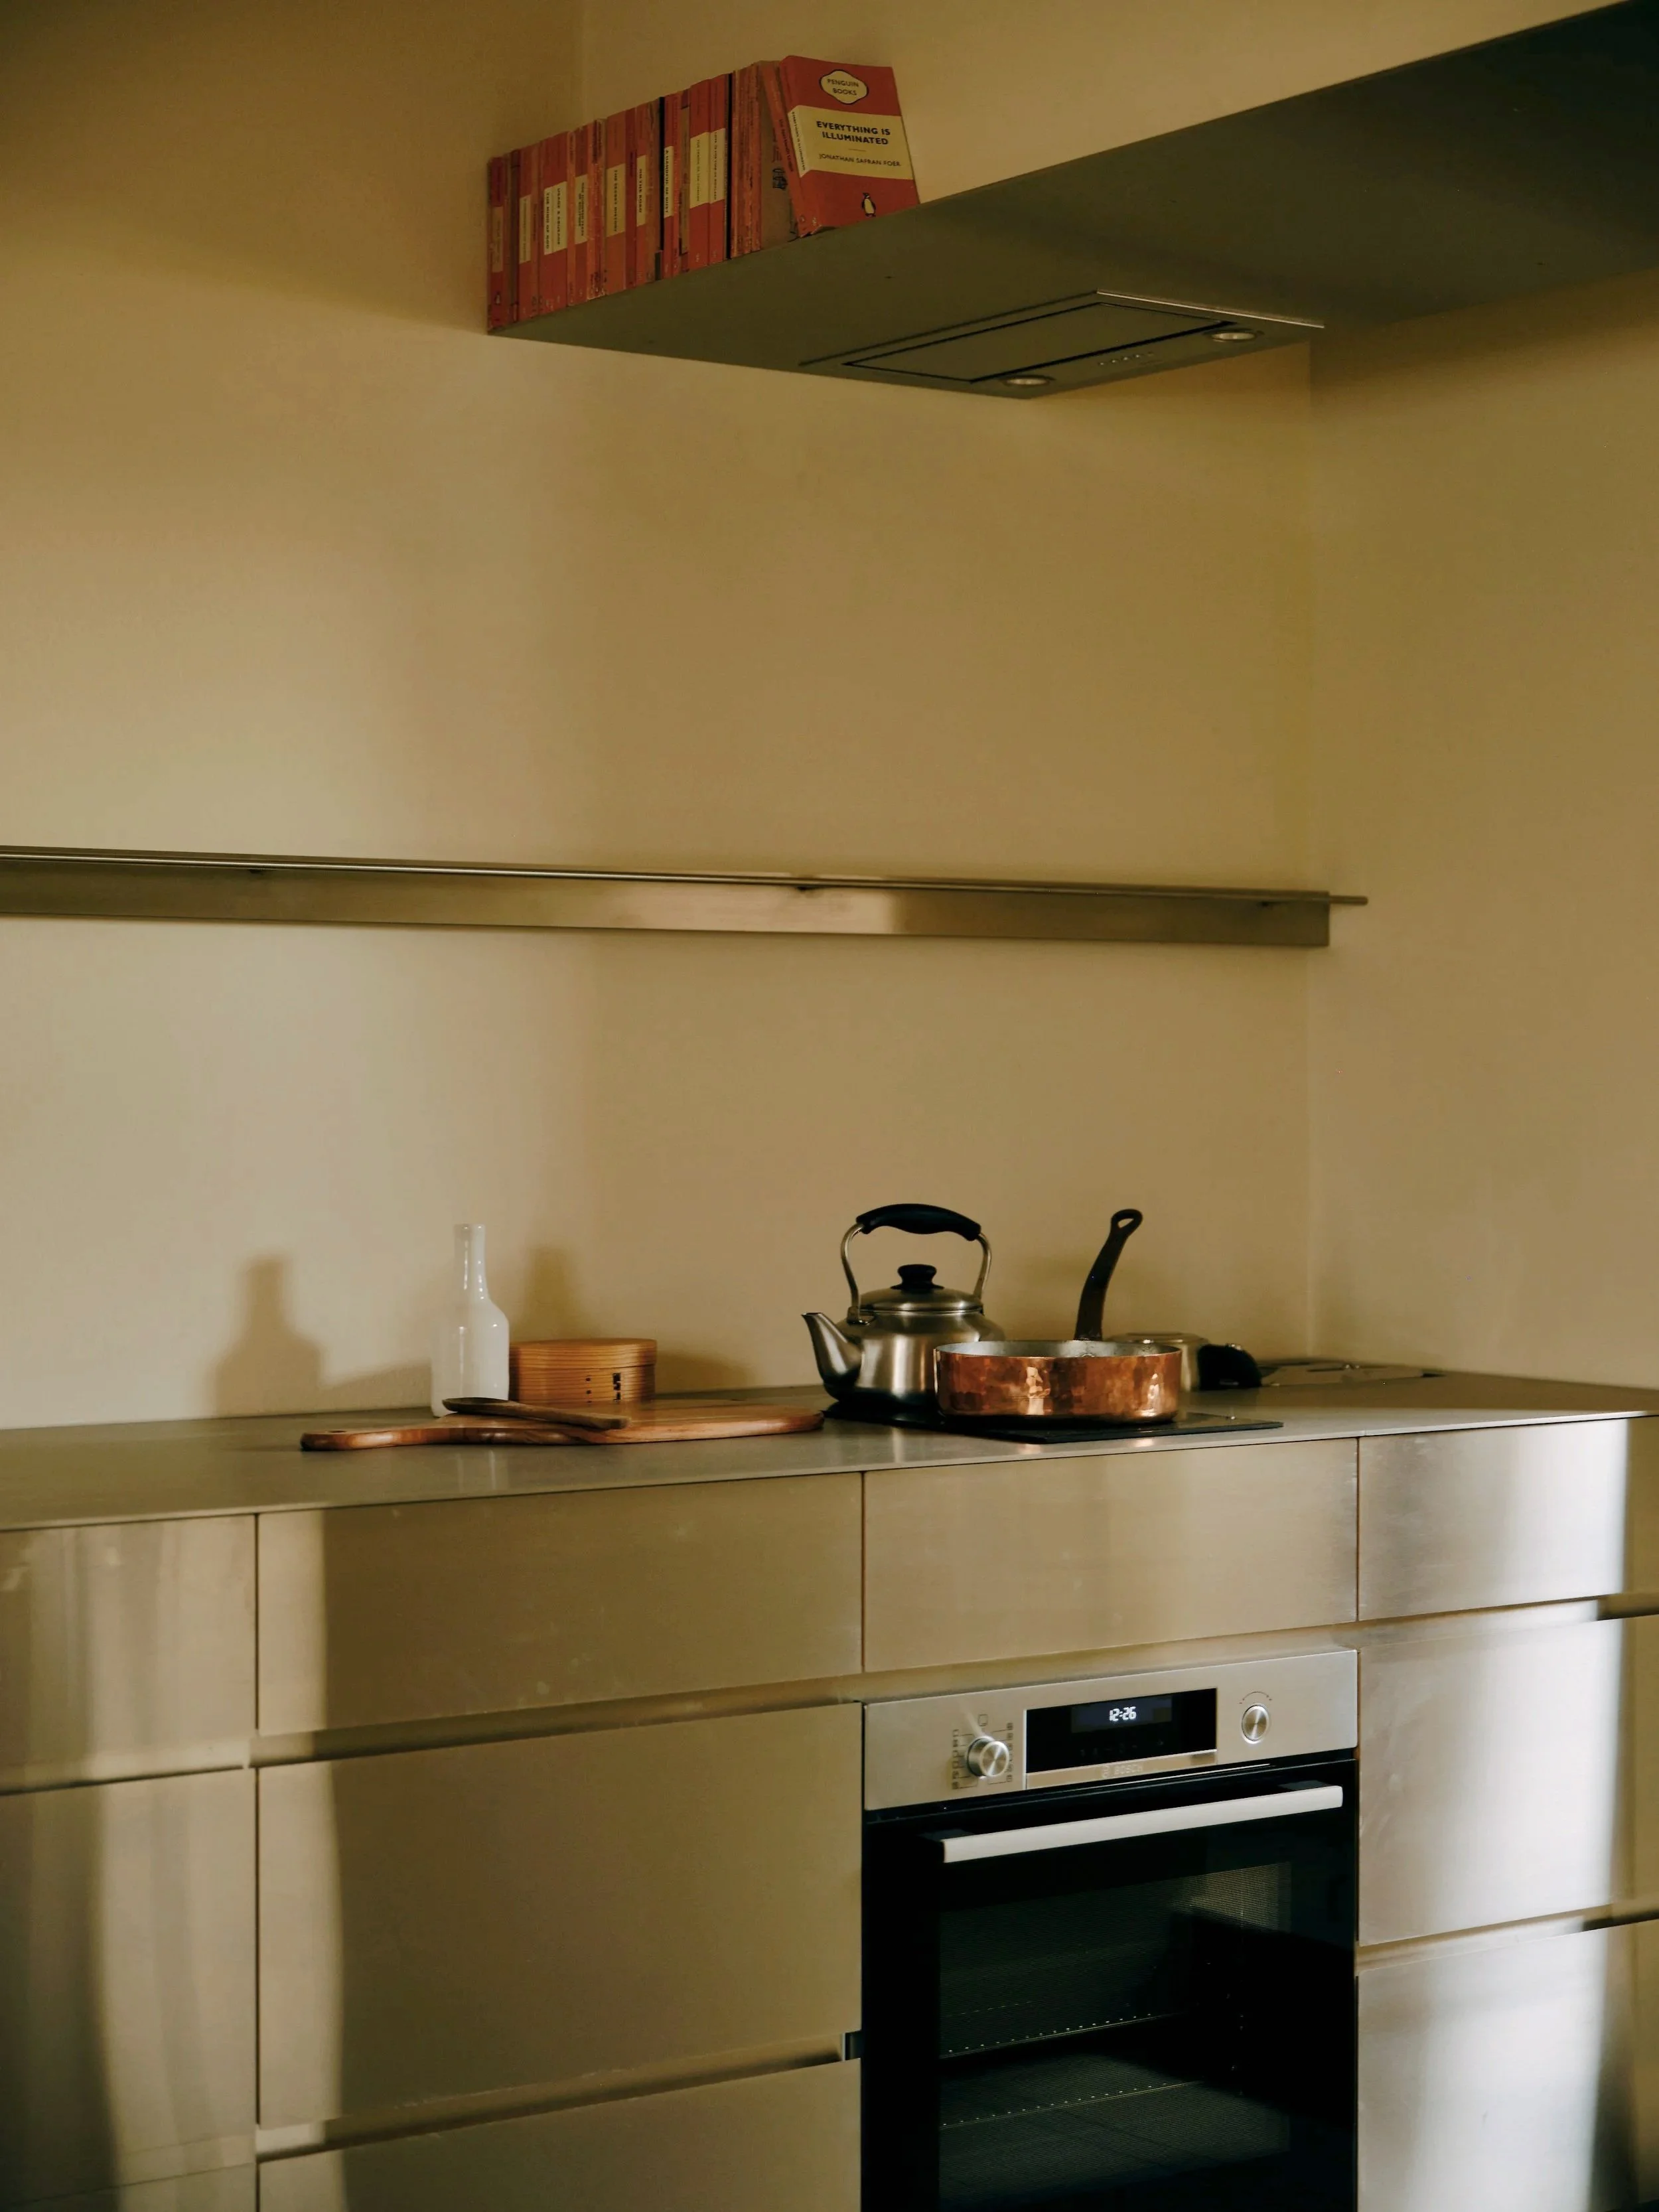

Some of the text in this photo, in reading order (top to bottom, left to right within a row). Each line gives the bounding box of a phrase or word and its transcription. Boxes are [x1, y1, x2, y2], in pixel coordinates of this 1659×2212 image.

[827, 78, 859, 88] PENGUIN
[833, 88, 857, 96] BOOKS
[816, 121, 879, 135] EVERYTHING
[822, 131, 889, 145] ILLUMINATED
[819, 153, 855, 163] JONATHAN
[1109, 1706, 1137, 1722] 12:26
